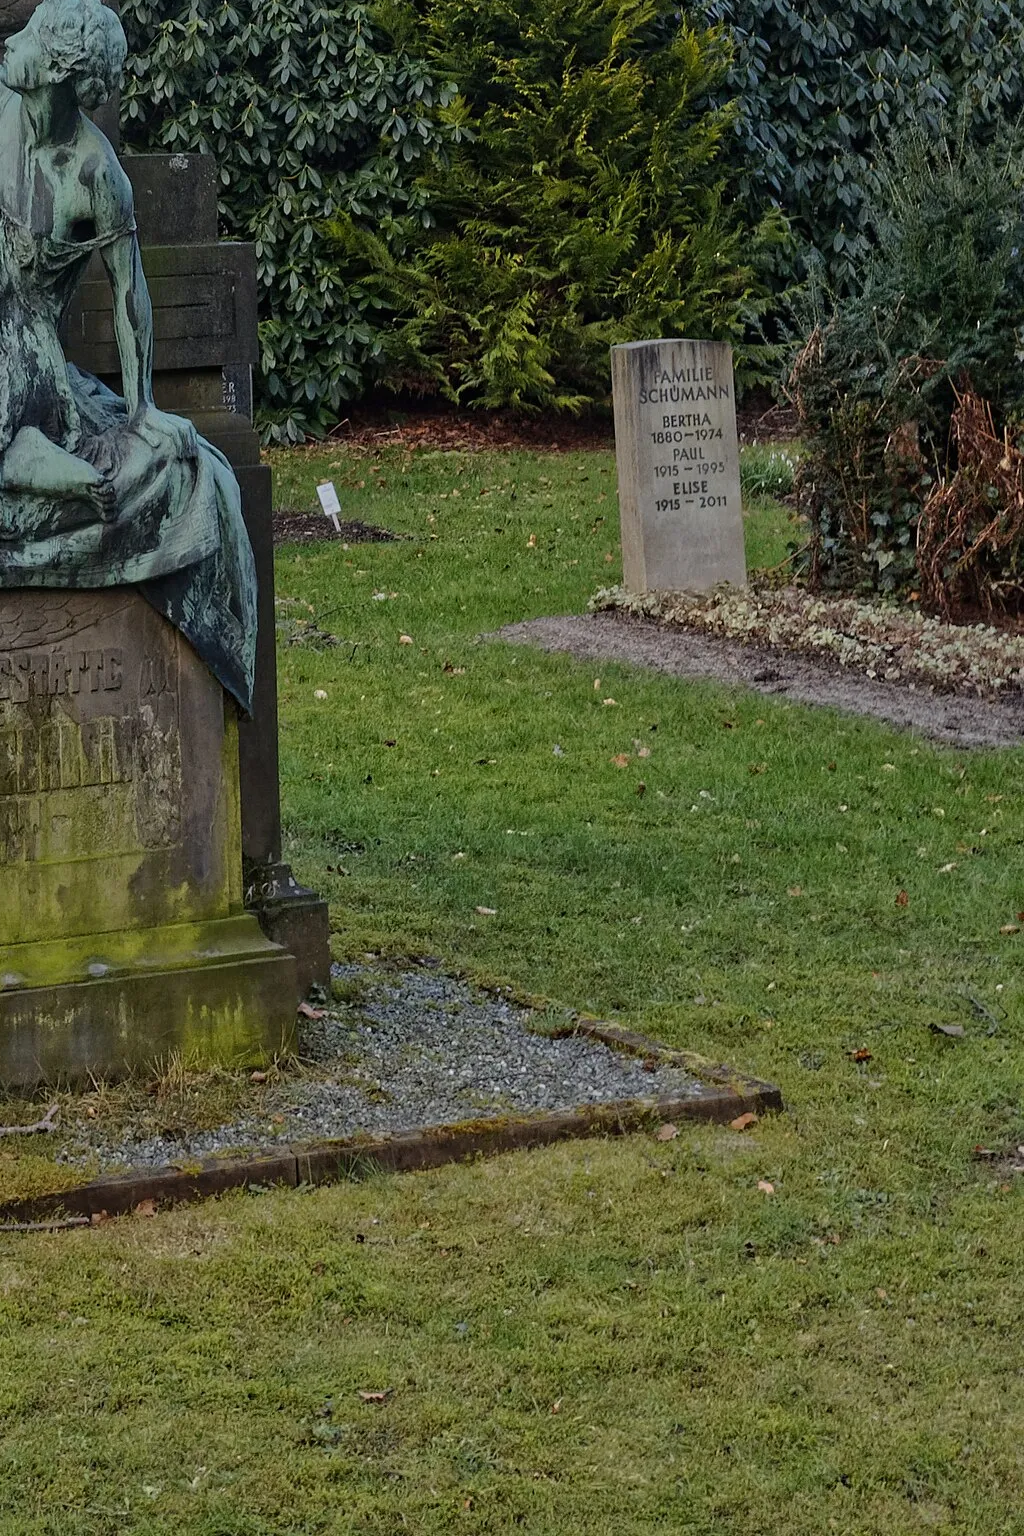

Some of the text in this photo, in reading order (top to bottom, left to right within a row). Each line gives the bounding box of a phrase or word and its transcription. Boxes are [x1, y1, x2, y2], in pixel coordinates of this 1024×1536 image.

[653, 367, 714, 384] FAMILIE
[662, 413, 712, 428] BERTHA
[673, 447, 705, 462] PAUL
[654, 465, 679, 478] 1915
[697, 461, 725, 475] 1995
[673, 480, 709, 496] ELISE
[655, 499, 681, 512] 1915
[699, 496, 727, 509] 2011
